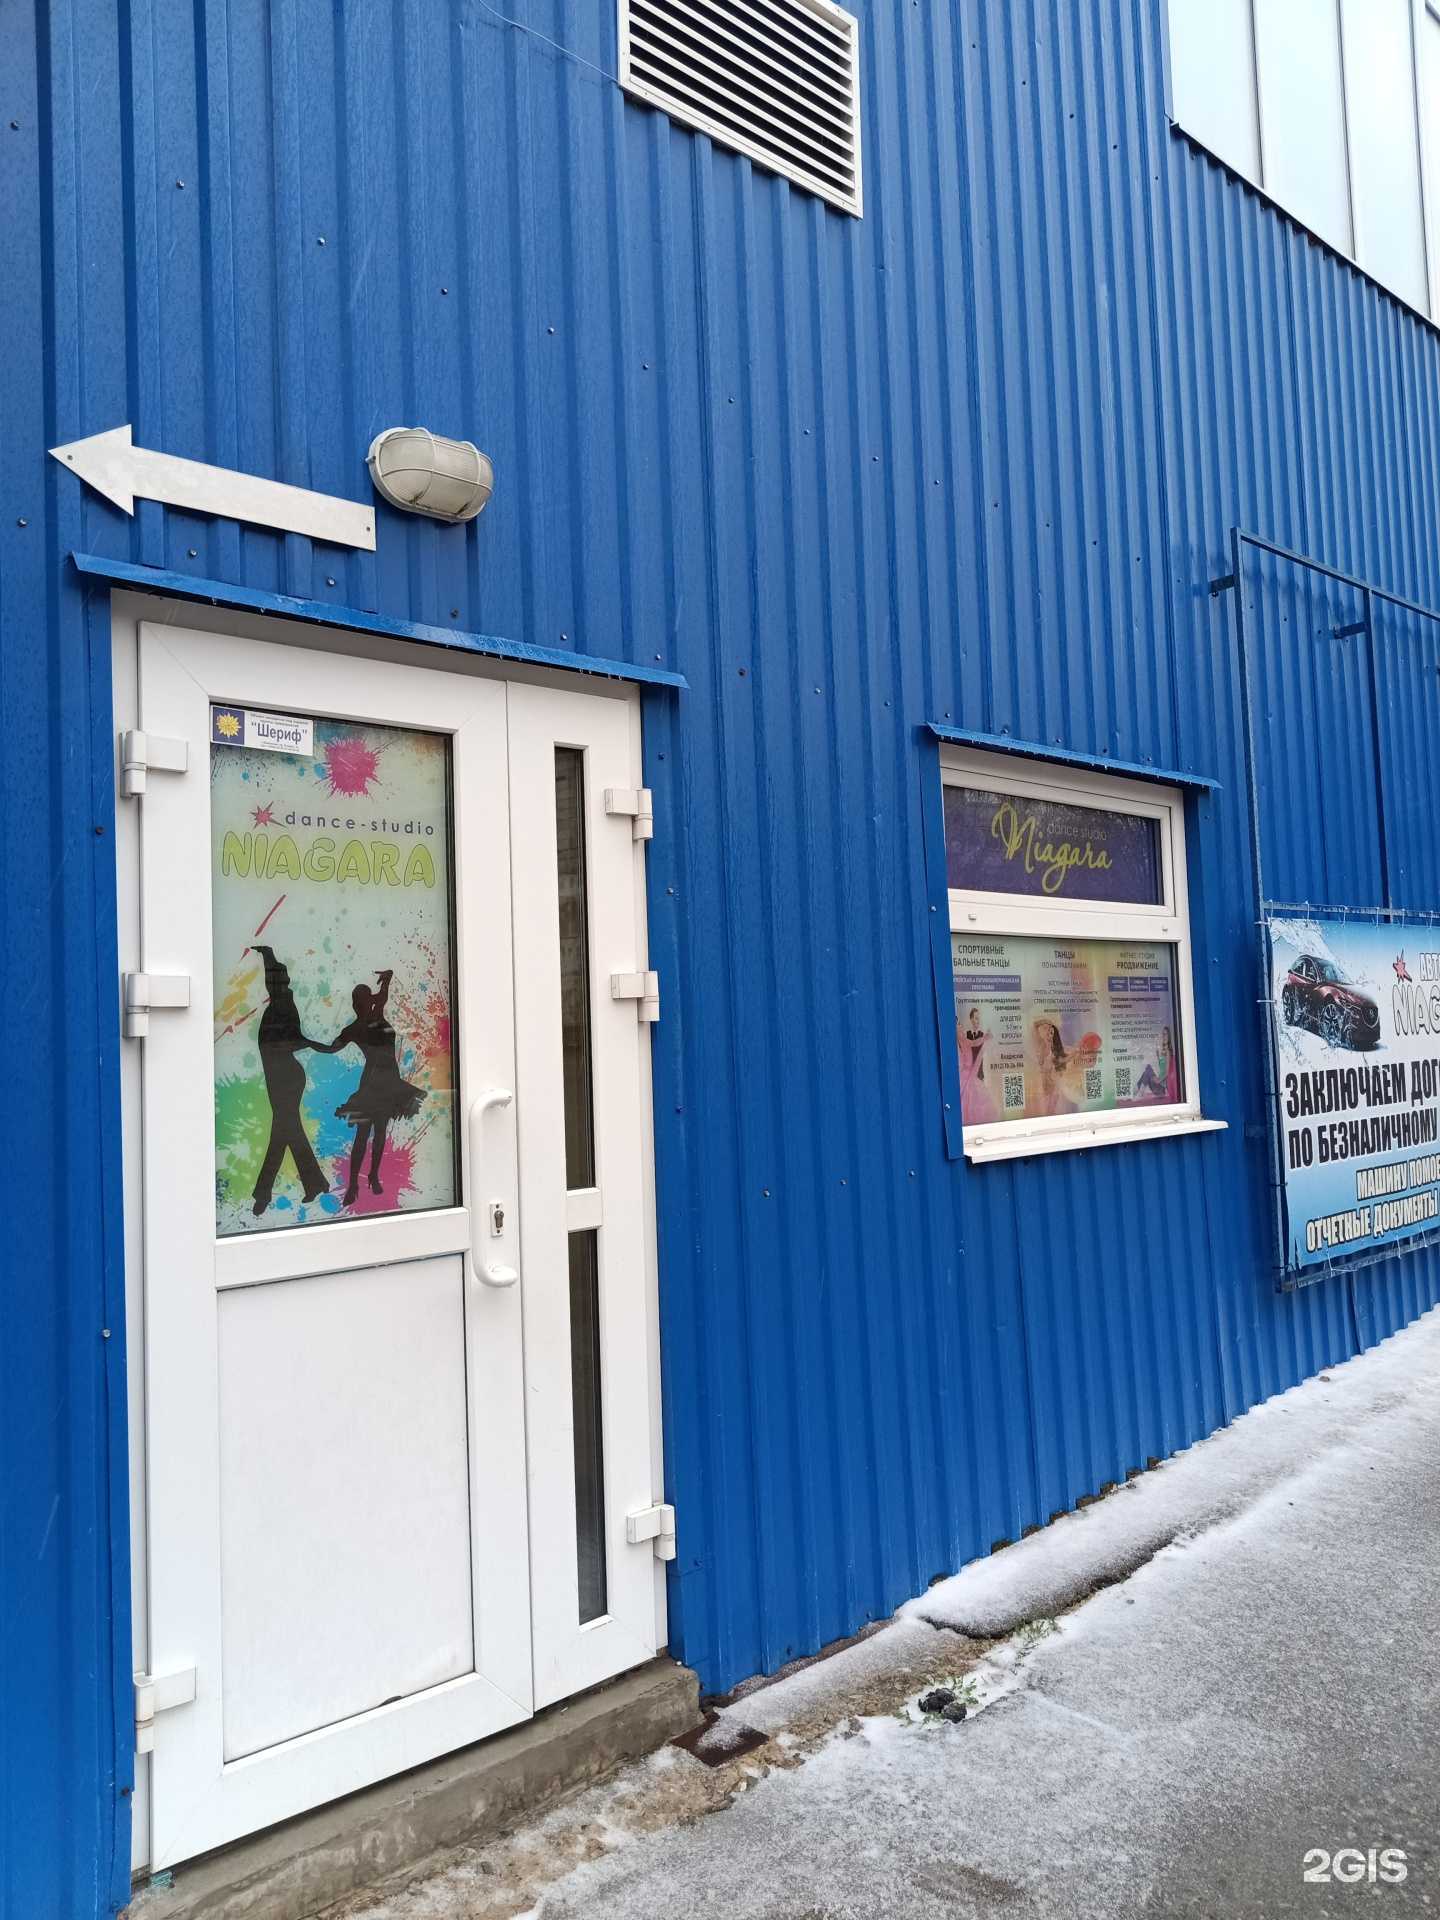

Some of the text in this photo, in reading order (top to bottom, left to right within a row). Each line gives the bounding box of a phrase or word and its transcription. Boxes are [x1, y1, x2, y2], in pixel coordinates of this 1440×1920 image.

[251, 721, 308, 745] "Шериф"
[285, 811, 435, 836] dance-studio
[221, 830, 436, 889] NIAGARA
[992, 801, 1113, 894] Niagara
[953, 957, 1010, 969] БАЛЬНЫЕ ТАНЦЫ
[957, 944, 1005, 956] СПОРТИВНЫЕ
[1054, 950, 1076, 960] ТАНЦЫ
[1285, 1058, 1440, 1119] ЗАКЛЮЧАЕМ ДОГ
[1288, 1107, 1438, 1170] ПО БЕЗНАЛИЧНОМУ
[1356, 1161, 1408, 1200] МАШИНУ
[1306, 1187, 1438, 1253] ОТЧЕТНЫЕ ДОКУМЕНТЫ
